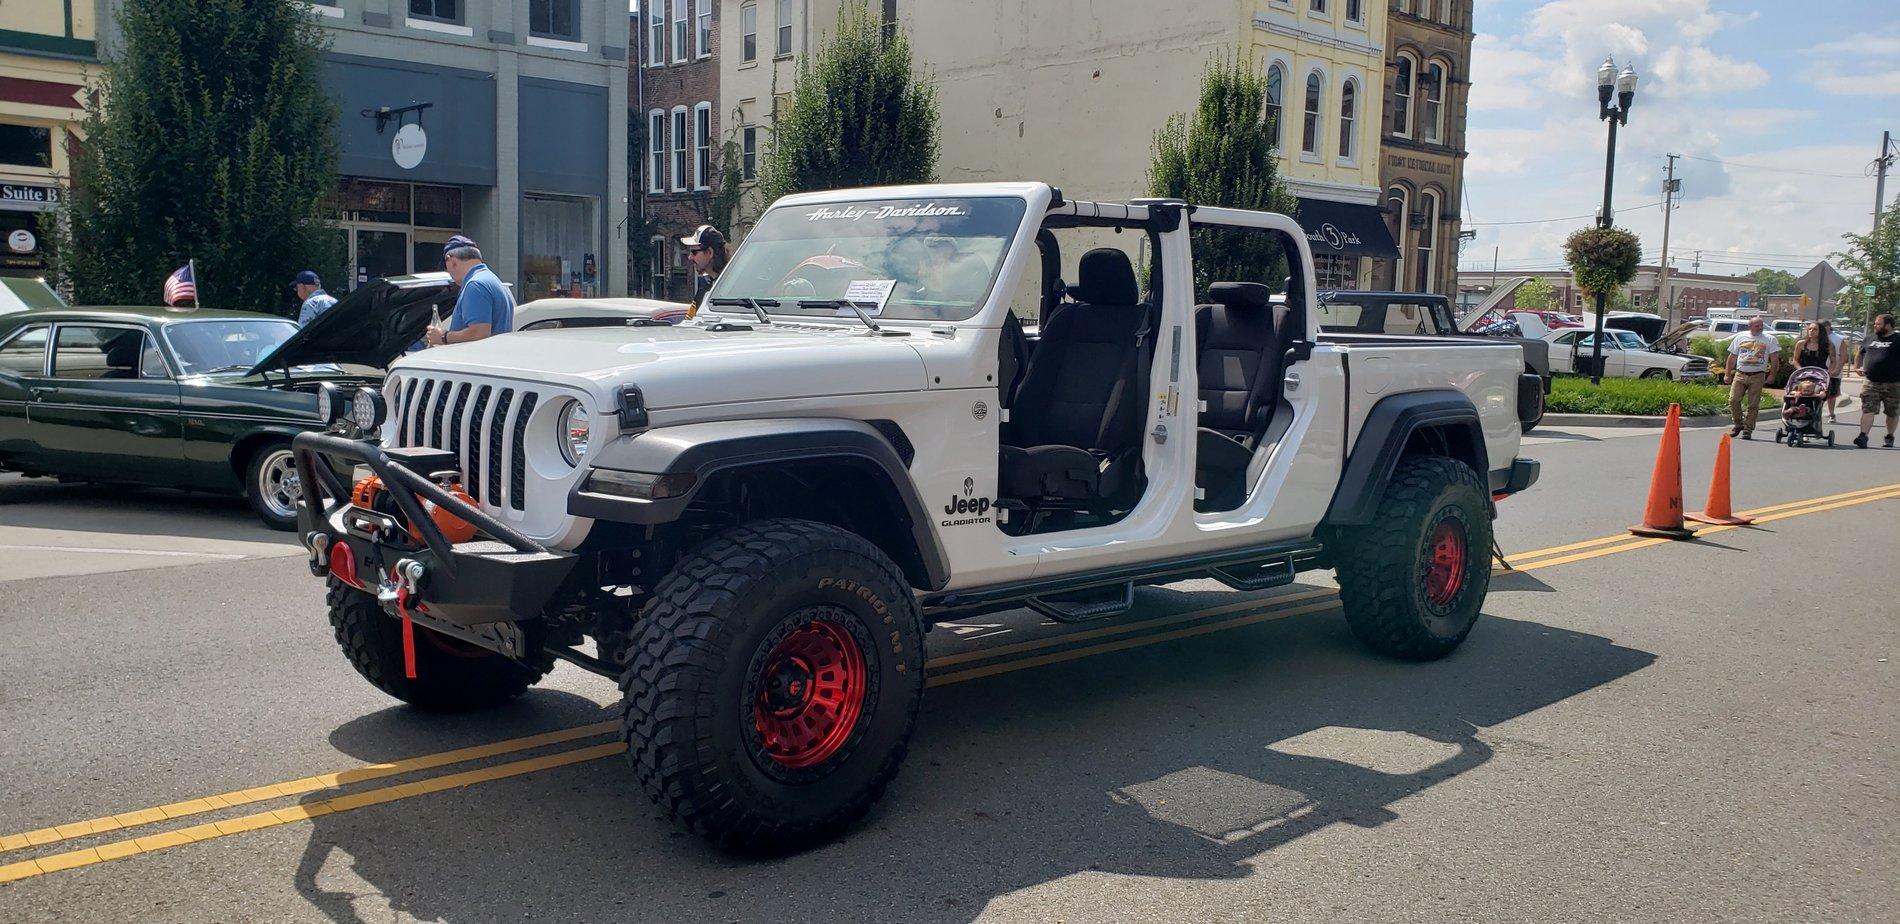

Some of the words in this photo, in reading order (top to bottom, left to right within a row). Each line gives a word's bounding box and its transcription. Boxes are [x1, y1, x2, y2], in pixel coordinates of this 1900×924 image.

[3, 185, 42, 201] Suite
[46, 187, 58, 202] B
[1341, 231, 1362, 245] Park
[944, 494, 990, 516] Jeep
[941, 517, 991, 527] GLADIATOR
[818, 578, 896, 624] PATRIOT
